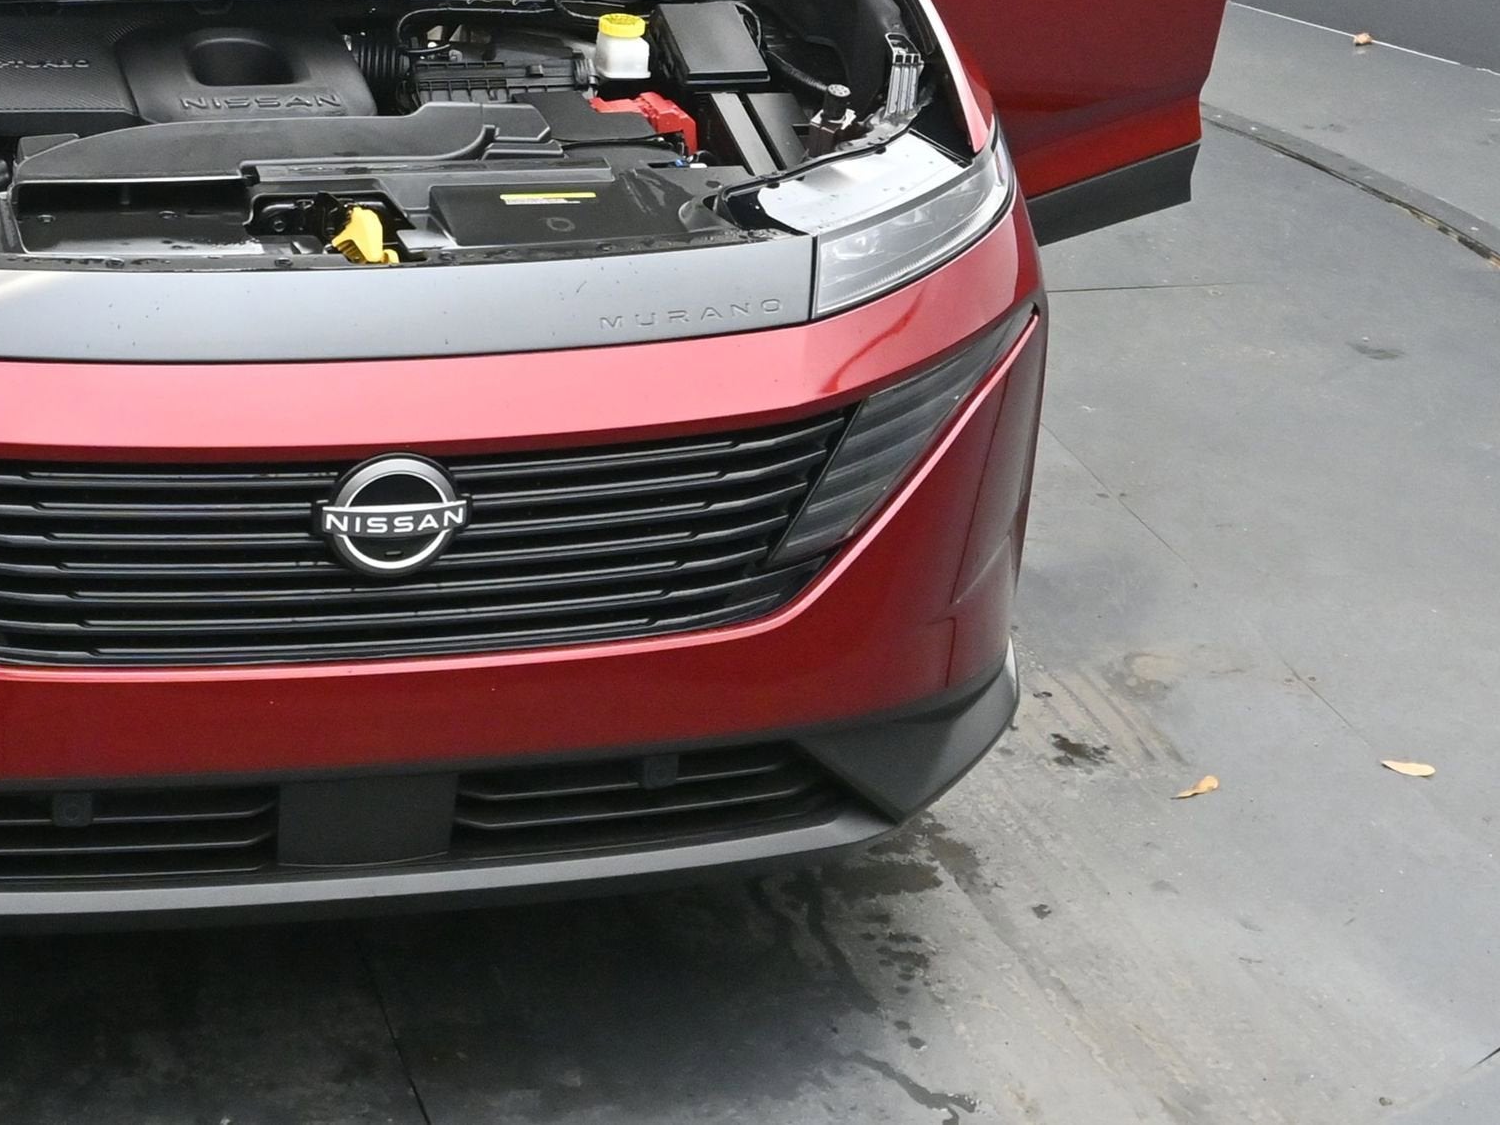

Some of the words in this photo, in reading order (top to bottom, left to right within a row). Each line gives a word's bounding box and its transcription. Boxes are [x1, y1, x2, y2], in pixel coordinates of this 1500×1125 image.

[179, 94, 342, 110] NISSAN
[600, 298, 782, 330] MURANO
[325, 507, 464, 534] NISSAN
